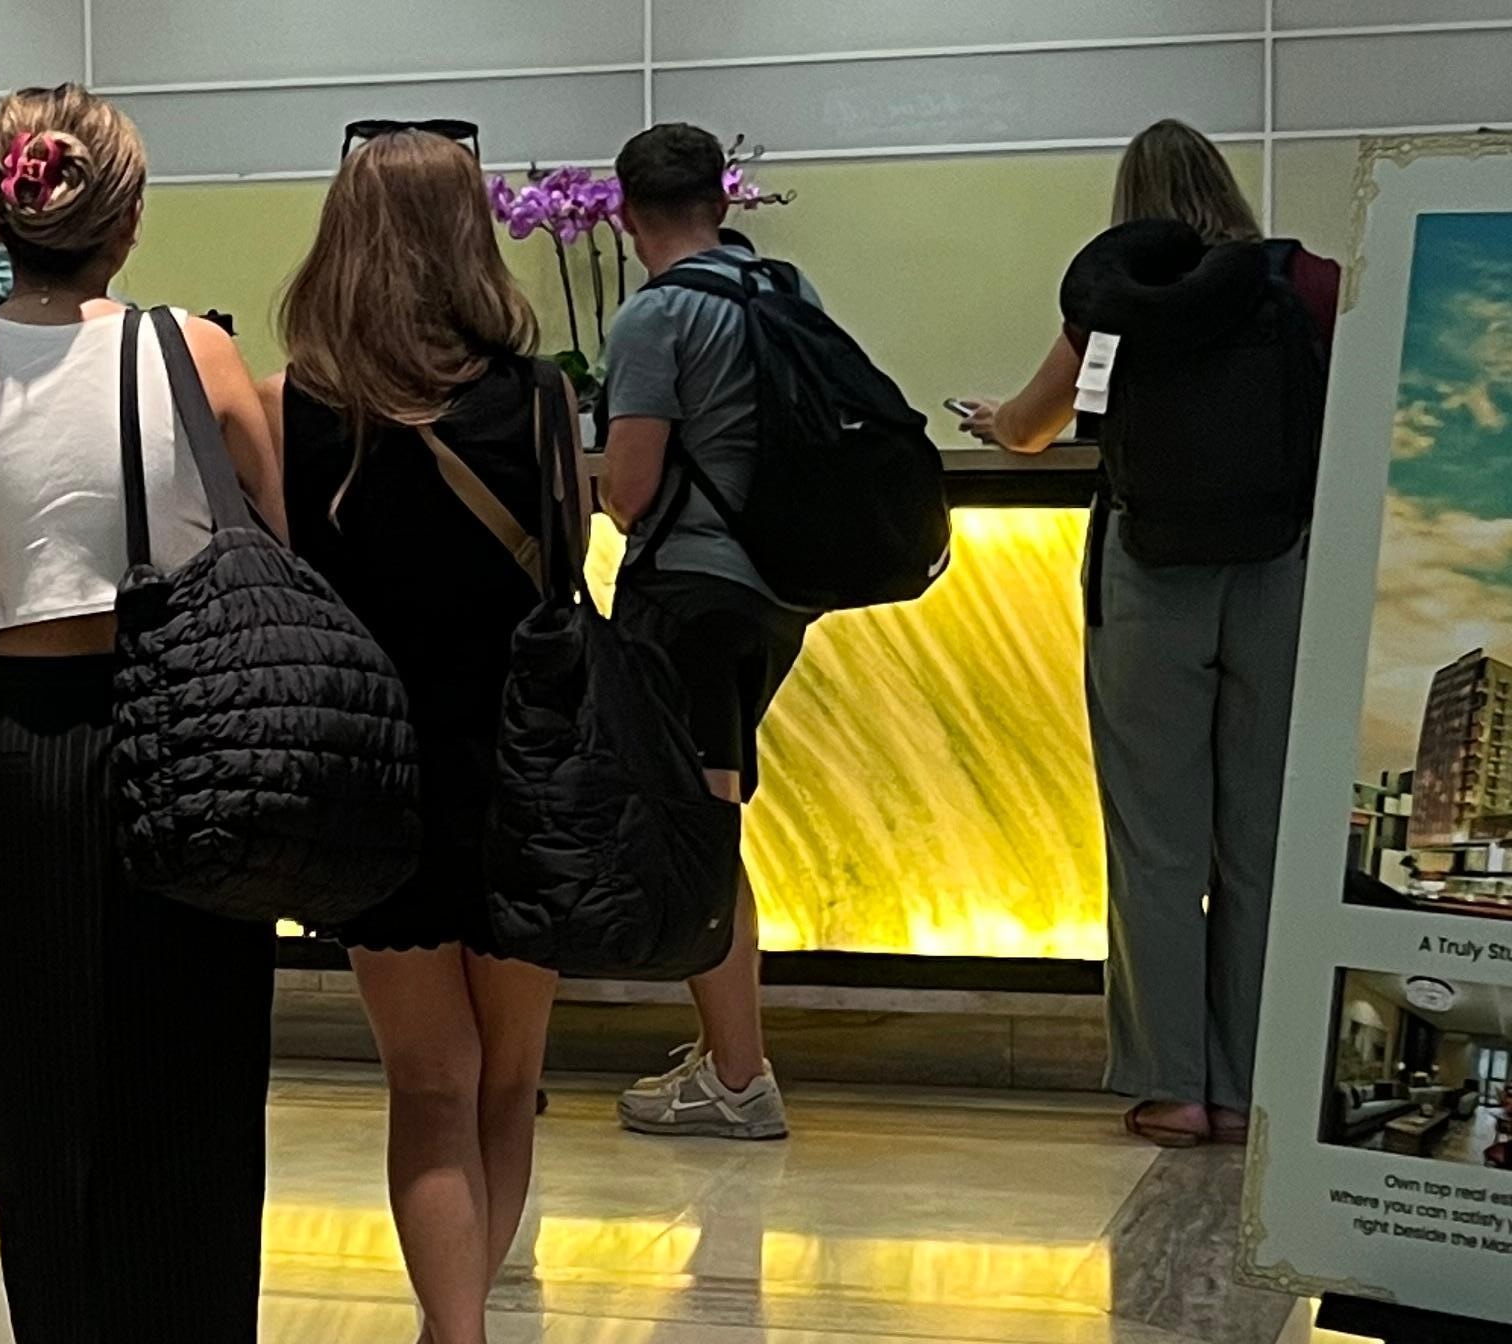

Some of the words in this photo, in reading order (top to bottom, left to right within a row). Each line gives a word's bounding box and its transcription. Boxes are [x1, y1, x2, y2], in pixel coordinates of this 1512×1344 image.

[1419, 937, 1431, 951] A
[1439, 937, 1483, 961] Truly
[1385, 1175, 1419, 1191] Own
[1425, 1182, 1451, 1199] top
[1455, 1187, 1486, 1201] real
[1330, 1190, 1378, 1208] Where
[1383, 1201, 1413, 1215] you
[1416, 1206, 1447, 1219] can
[1353, 1217, 1389, 1235] right
[1394, 1223, 1446, 1242] beside
[1451, 1232, 1476, 1247] the
